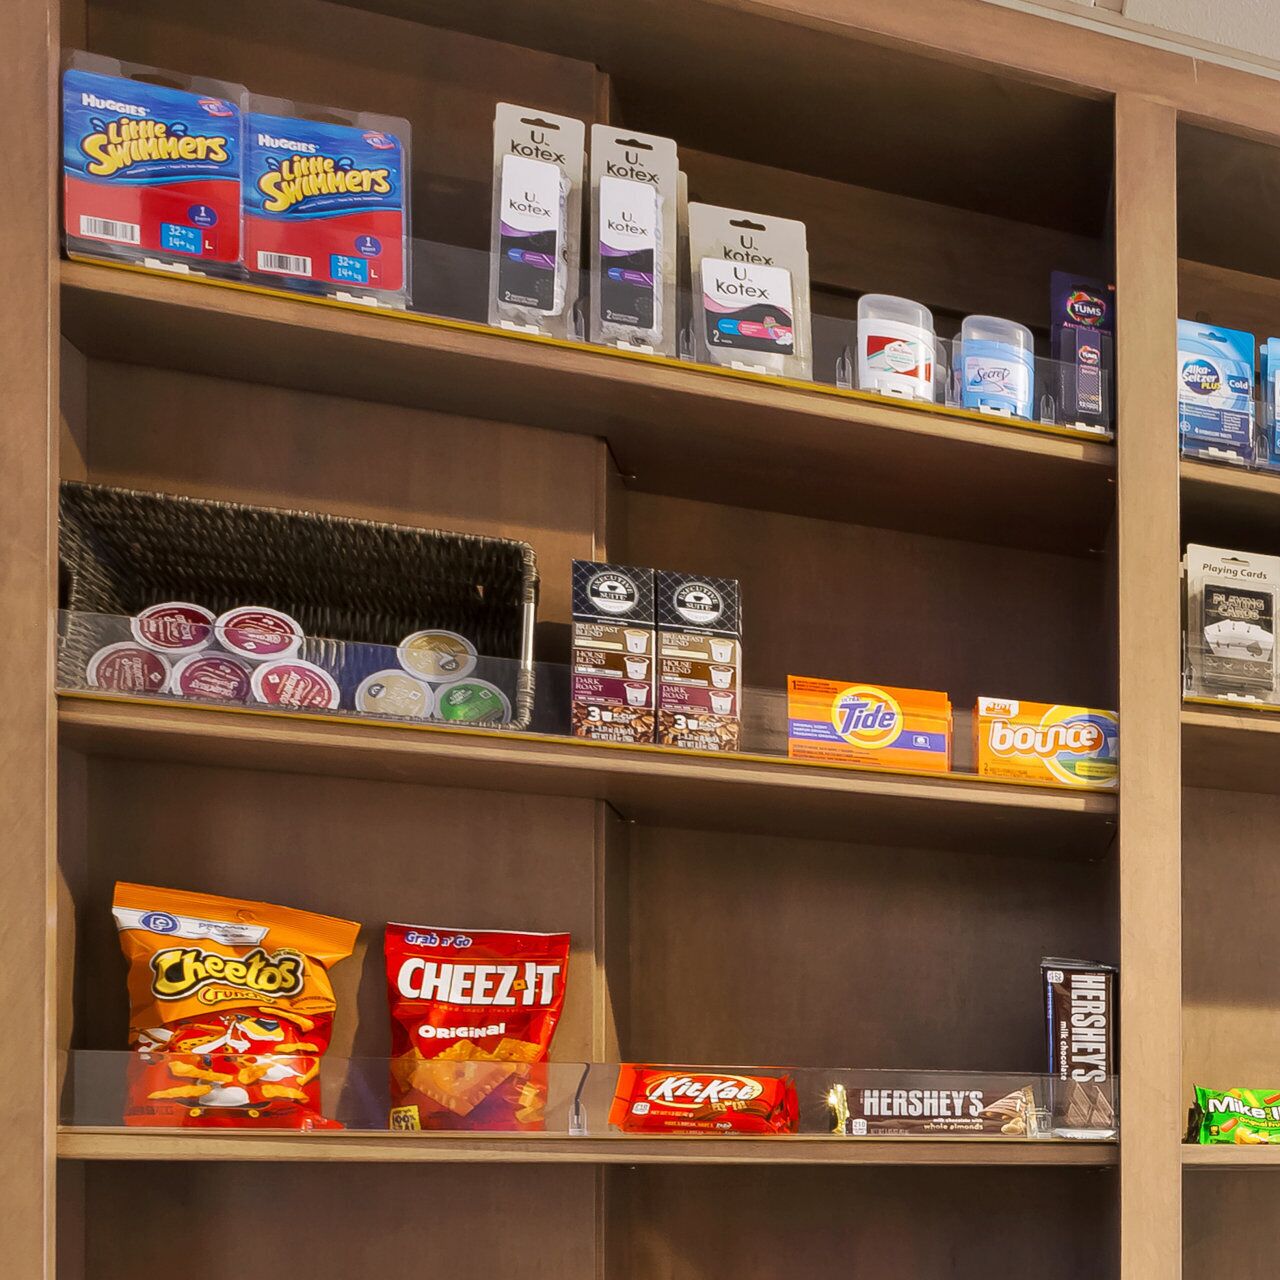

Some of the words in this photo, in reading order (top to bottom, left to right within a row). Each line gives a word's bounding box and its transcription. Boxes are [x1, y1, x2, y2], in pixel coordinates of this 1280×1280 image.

[82, 93, 147, 116] HUGGIES
[109, 118, 166, 144] Little
[258, 134, 317, 153] HUGGIES
[282, 155, 335, 179] Little
[1074, 304, 1101, 316] TUMS
[1229, 380, 1248, 389] Cold
[1202, 563, 1239, 578] Playing
[1239, 568, 1267, 580] Cards
[1212, 593, 1264, 611] PLAYING
[1218, 605, 1260, 621] CARDS
[588, 707, 600, 722] 3
[674, 714, 686, 729] 3
[840, 702, 896, 735] Tide
[991, 721, 1098, 753] bounce
[405, 932, 438, 946] Grab
[453, 935, 472, 947] Go
[153, 950, 299, 995] Cheetos
[1071, 974, 1106, 1083] HERSHEY'S
[864, 1089, 983, 1117] HERSHEY'S
[1208, 1098, 1265, 1117] Mike
